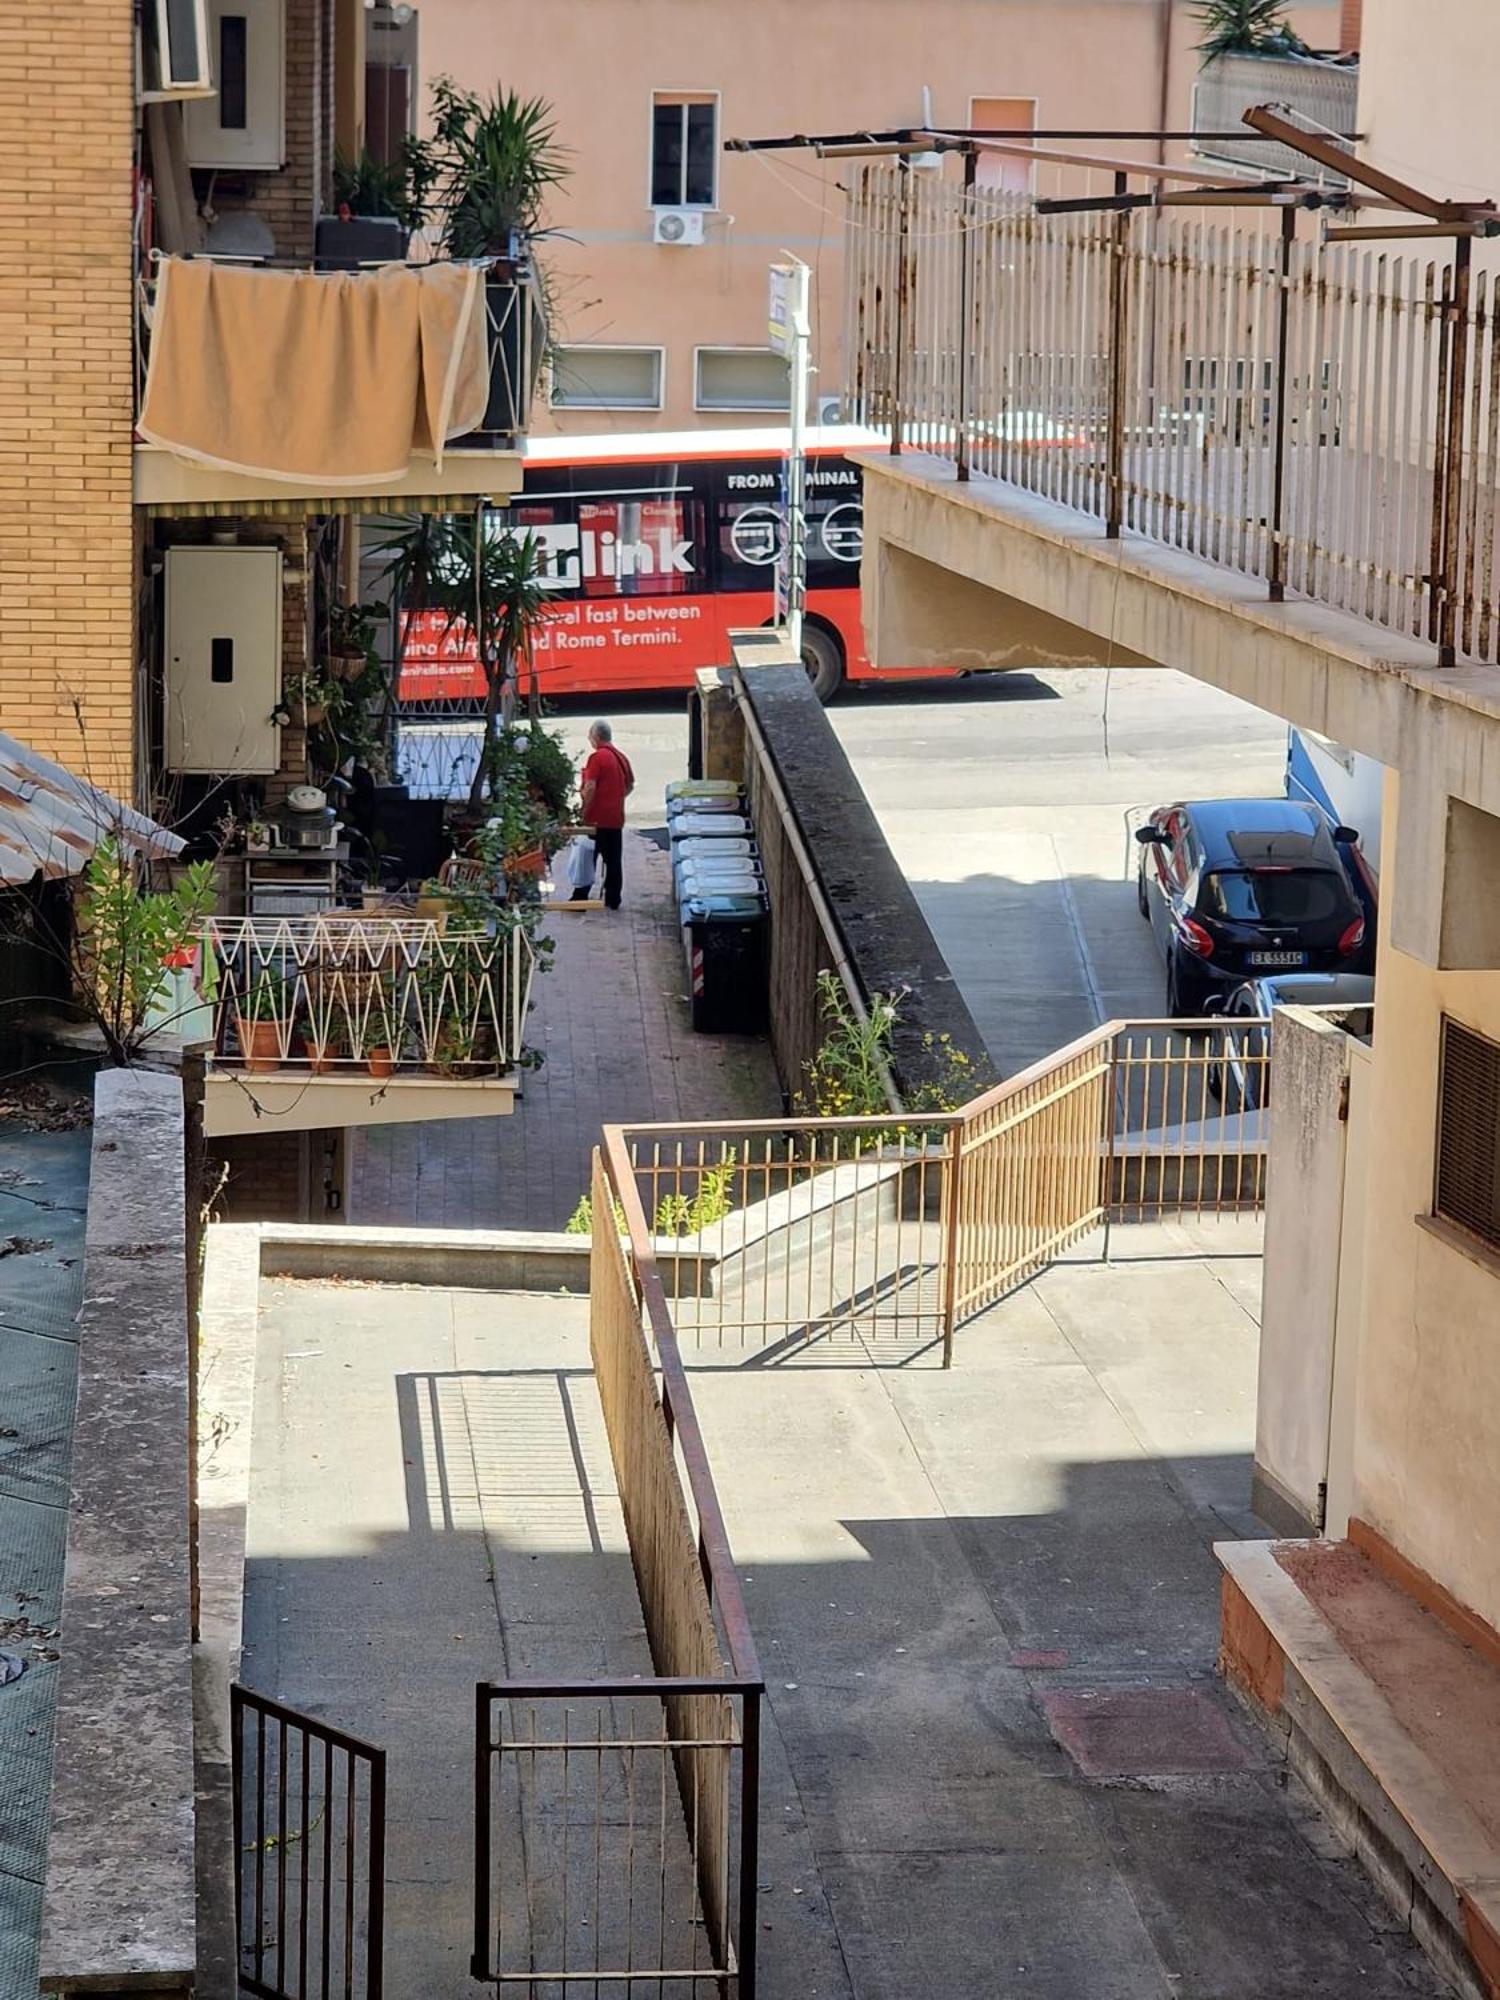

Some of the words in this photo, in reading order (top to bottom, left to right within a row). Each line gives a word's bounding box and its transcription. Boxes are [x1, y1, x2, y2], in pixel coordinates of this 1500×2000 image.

[727, 474, 775, 489] FROM
[778, 471, 858, 491] MINAL
[498, 526, 696, 582] irlink
[586, 604, 618, 624] fast
[624, 603, 701, 622] between
[556, 631, 607, 649] Rome
[612, 627, 682, 646] Termini.
